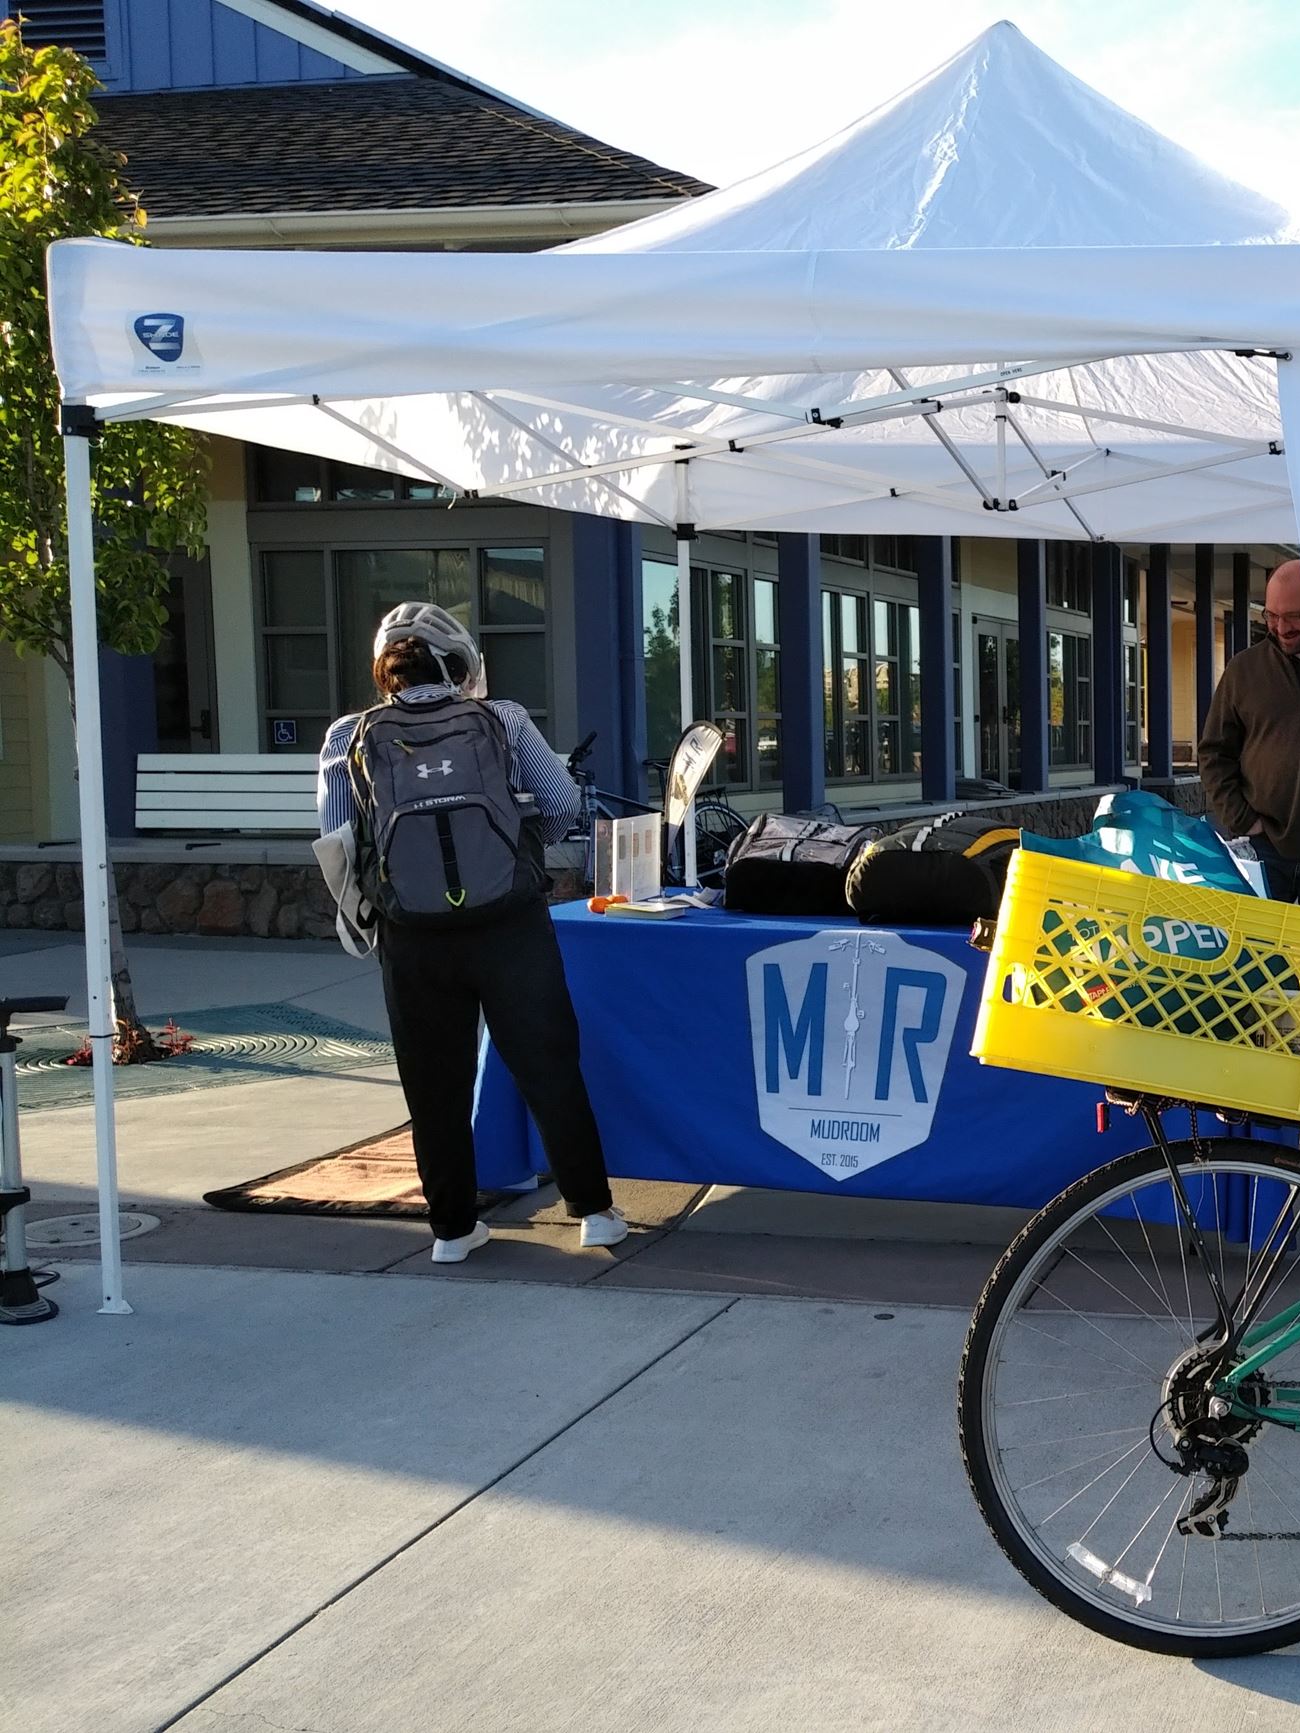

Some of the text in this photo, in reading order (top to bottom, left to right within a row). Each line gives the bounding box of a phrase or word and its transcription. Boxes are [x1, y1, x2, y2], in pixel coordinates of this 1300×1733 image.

[425, 795, 466, 807] STORM
[810, 1118, 881, 1143] MUDROOM
[821, 1153, 859, 1169] EST. 2015
